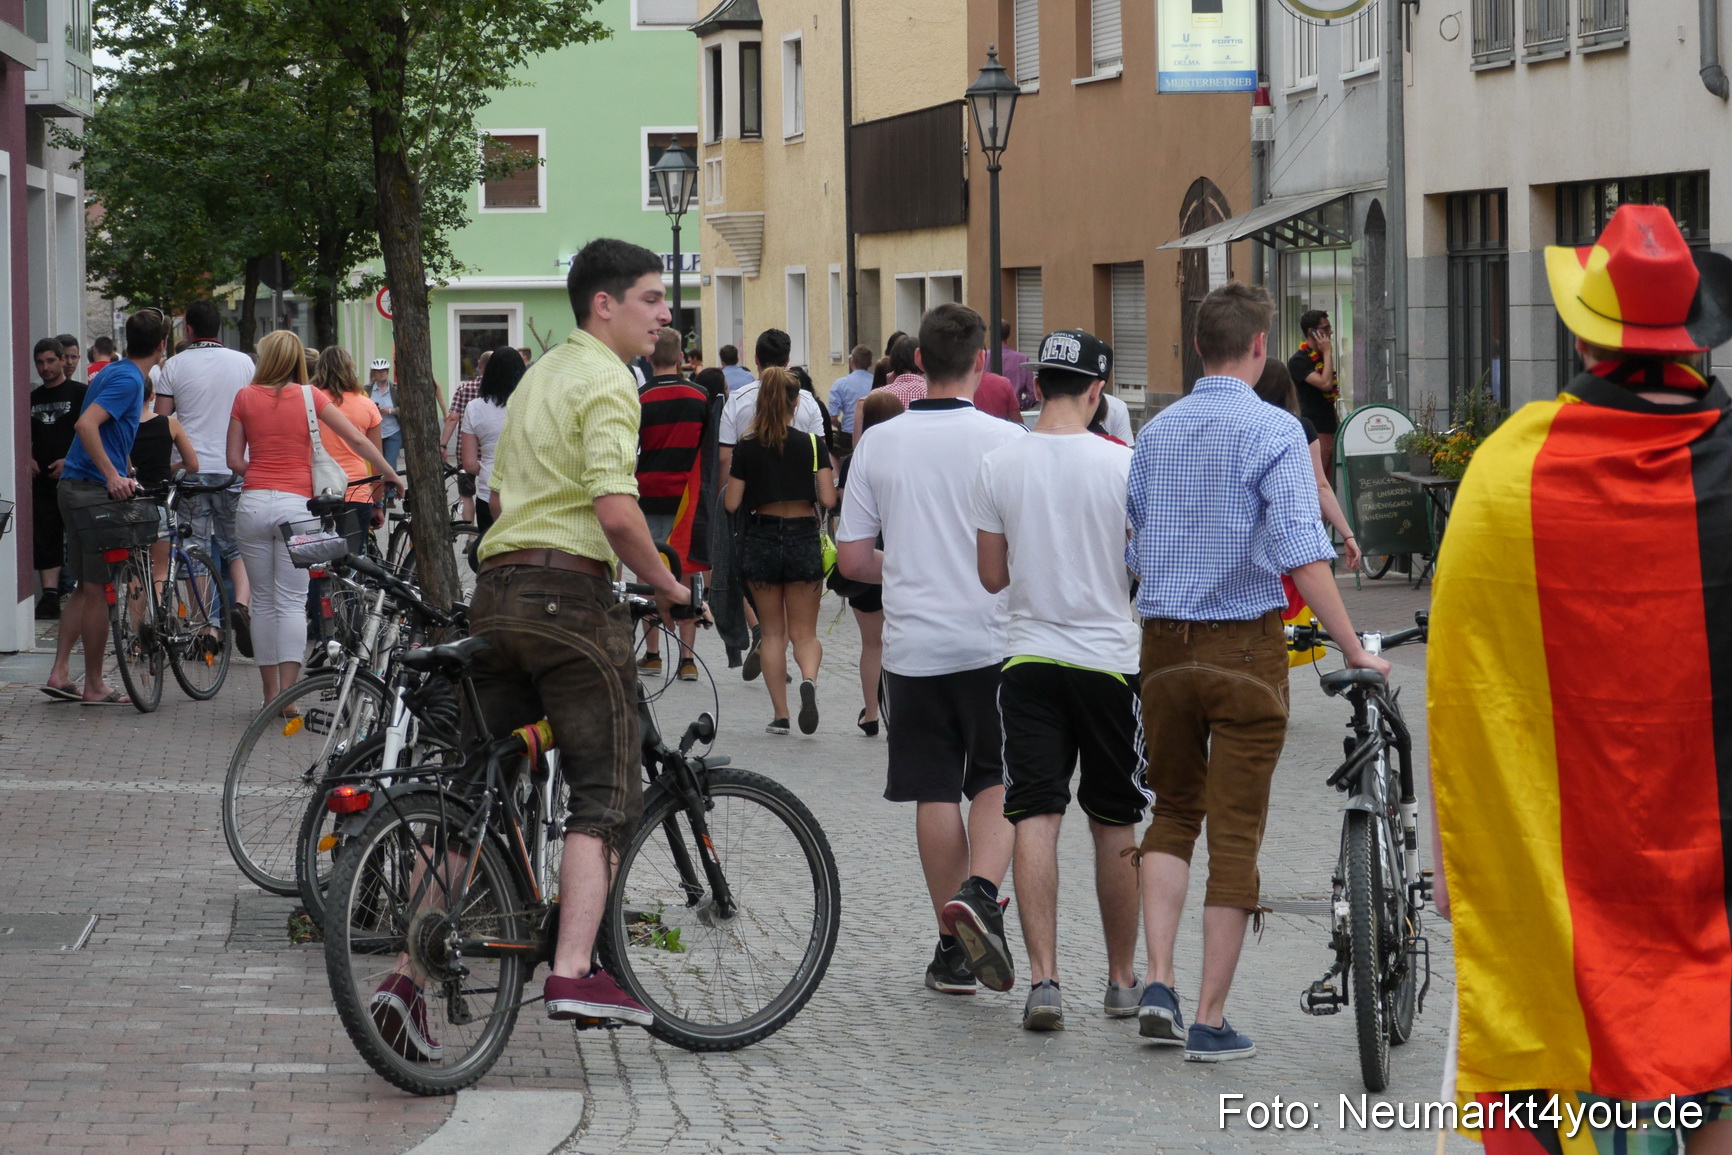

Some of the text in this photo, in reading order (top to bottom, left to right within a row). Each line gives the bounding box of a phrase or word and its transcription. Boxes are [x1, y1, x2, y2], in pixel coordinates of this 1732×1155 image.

[1164, 77, 1252, 88] MEISTERBETRIEB
[1040, 336, 1081, 363] NETS
[1359, 476, 1406, 489] BESUCHE
[1377, 487, 1411, 498] UNSEREN
